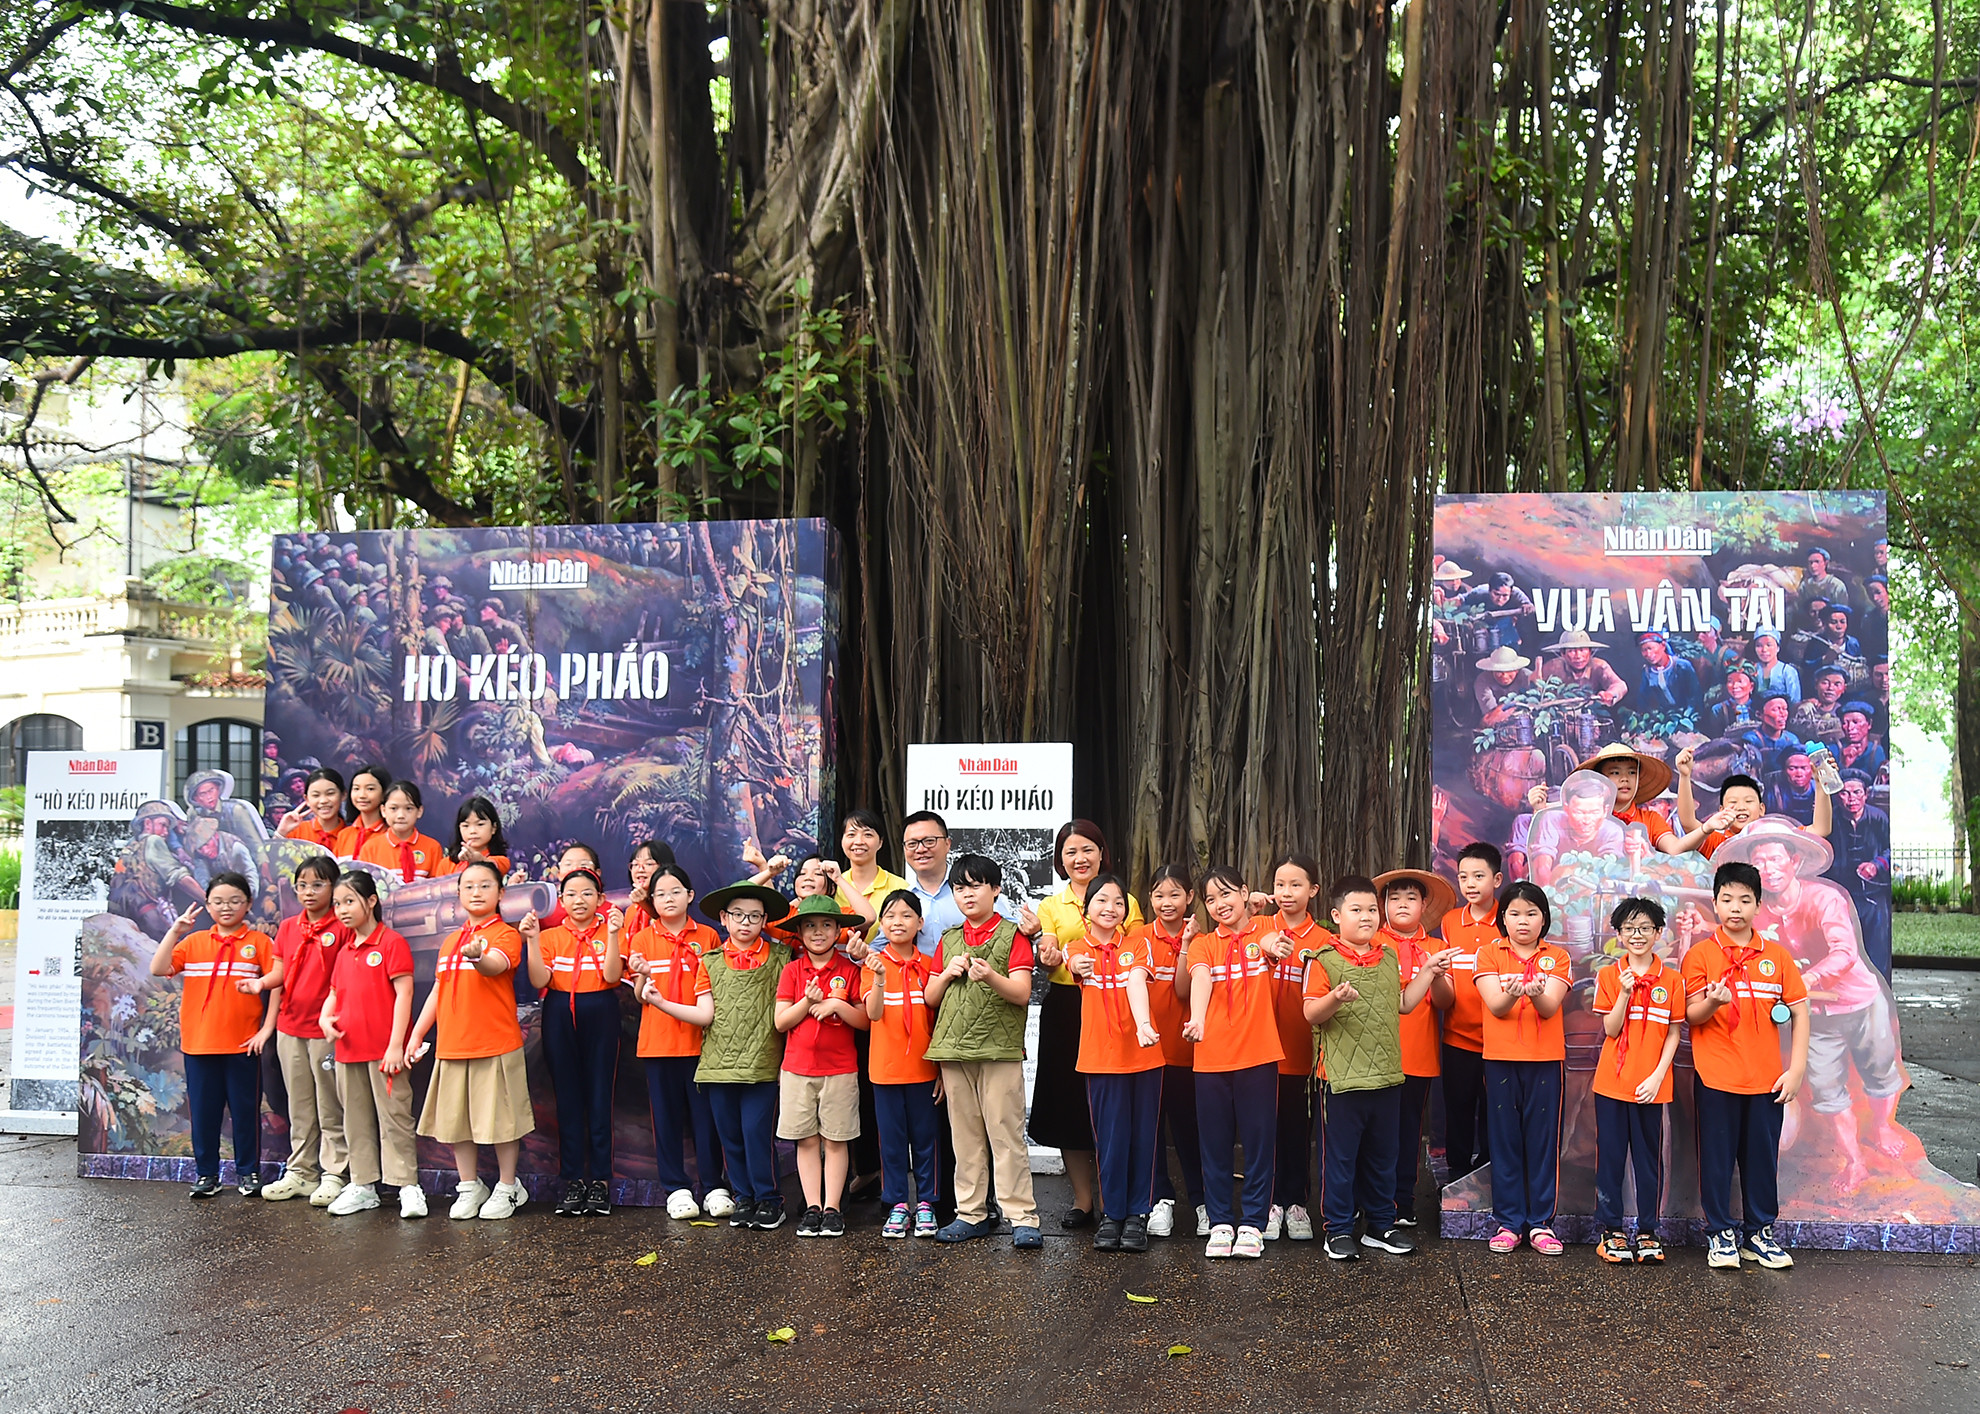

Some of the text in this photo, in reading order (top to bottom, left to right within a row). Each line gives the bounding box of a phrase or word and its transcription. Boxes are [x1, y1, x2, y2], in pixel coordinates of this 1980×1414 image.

[1604, 526, 1712, 550] Nhân Dân
[489, 559, 589, 584] Nhân Dân
[1532, 587, 1615, 632] VUA
[1626, 579, 1711, 639] VẬN
[403, 642, 669, 701] HÒ KÉO PHÁO
[141, 724, 160, 745] B
[69, 760, 117, 771] Nhân Dân
[959, 758, 1018, 771] Nhân Dân
[68, 789, 95, 810] KÉO
[924, 784, 1053, 810] HÒ KÉO PHÁO
